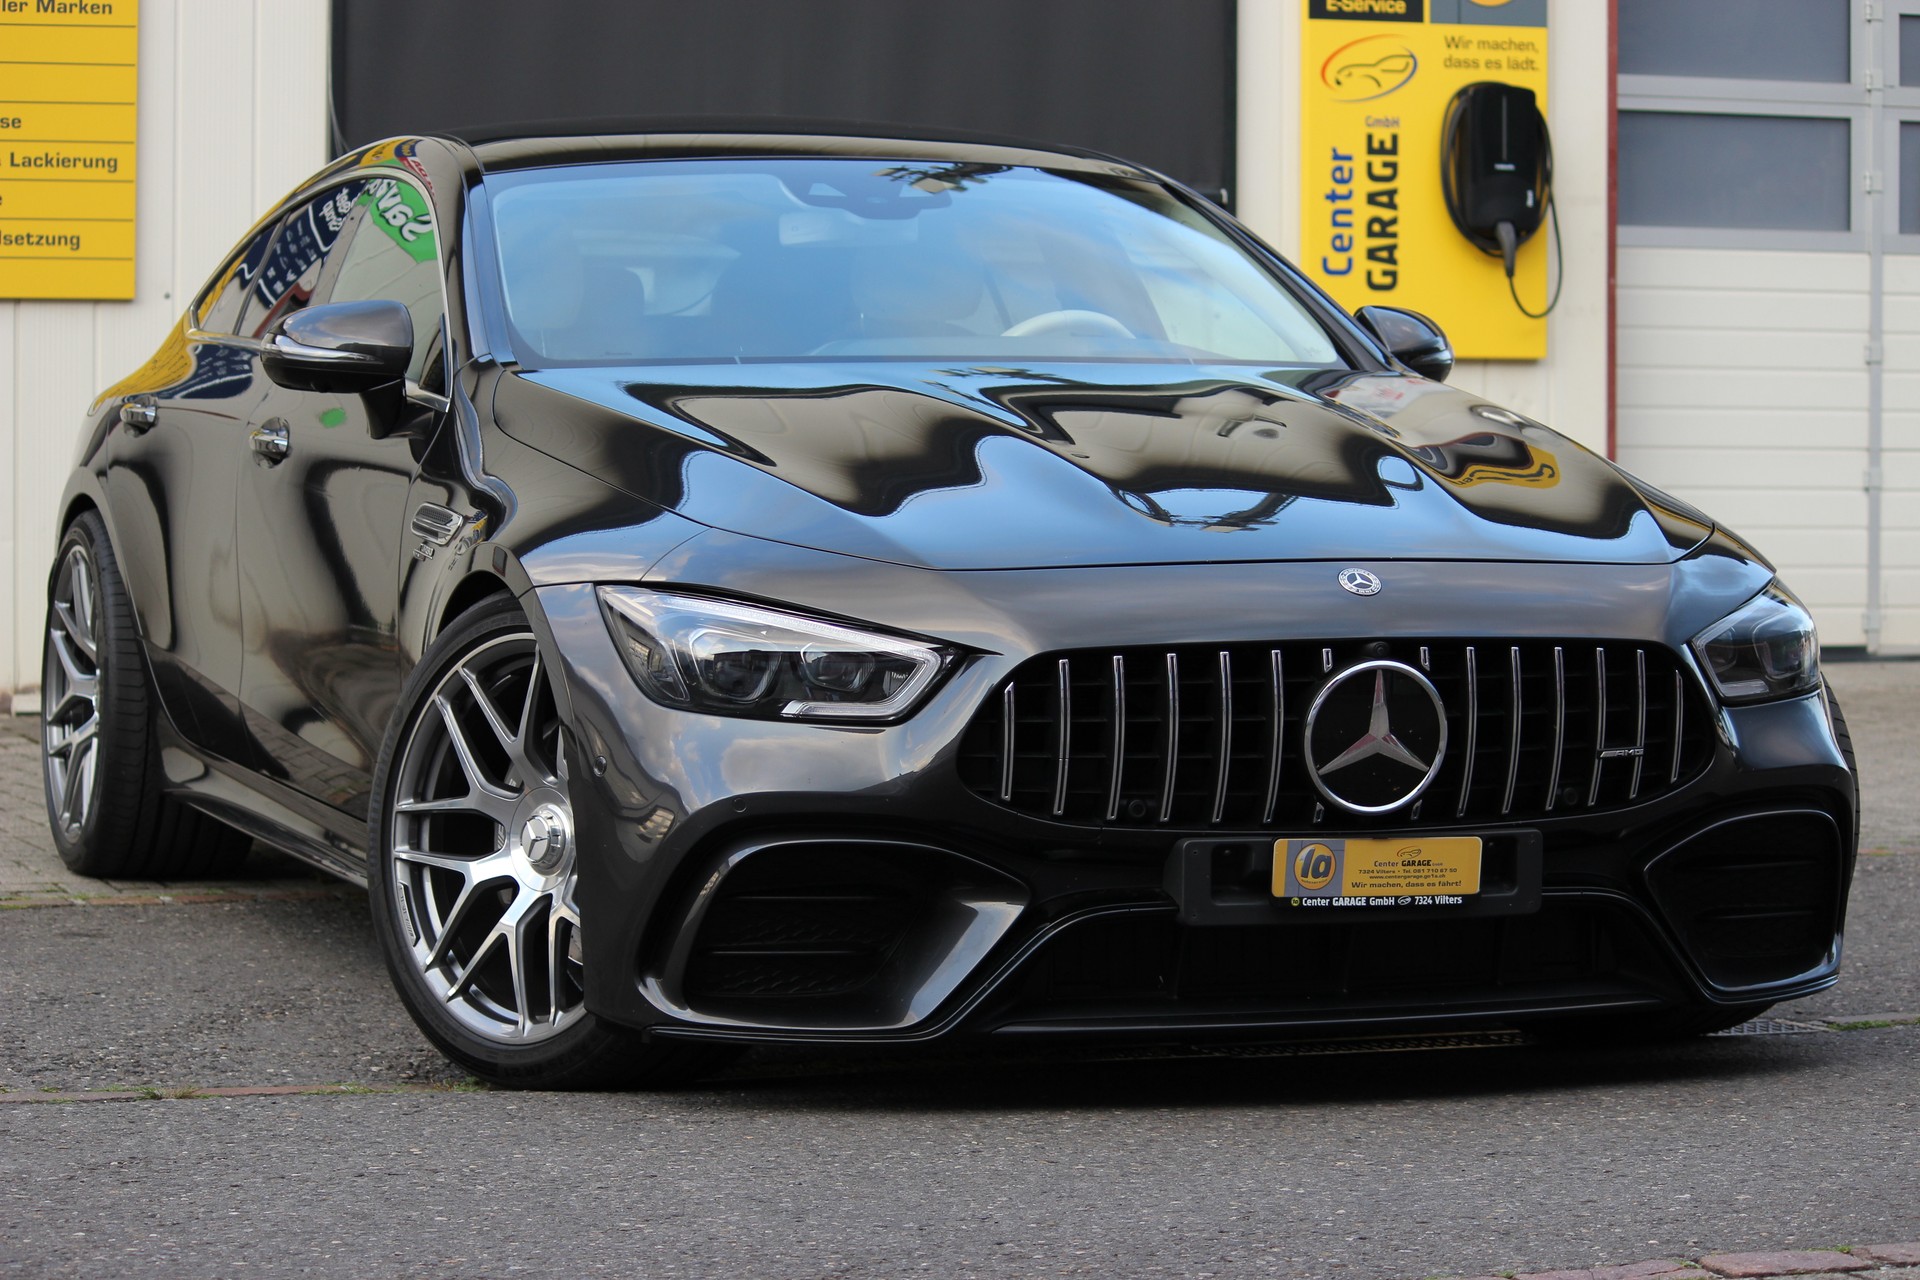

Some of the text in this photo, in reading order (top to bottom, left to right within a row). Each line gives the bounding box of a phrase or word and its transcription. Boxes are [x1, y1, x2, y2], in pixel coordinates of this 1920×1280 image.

[36, 0, 112, 15] Marken
[1326, 0, 1407, 14] E-Service
[1444, 36, 1539, 53] Wir machen,
[1443, 55, 1540, 72] dass es lädt.
[10, 151, 118, 173] Lackierung
[1322, 147, 1353, 276] Center
[1367, 133, 1398, 291] GARAGE
[0, 229, 80, 251] setzung
[1302, 897, 1330, 906] Center
[1332, 897, 1367, 906] GARAGE
[1369, 896, 1395, 906] GmbH
[1414, 896, 1433, 905] 7324
[1435, 895, 1462, 905] Vilters
